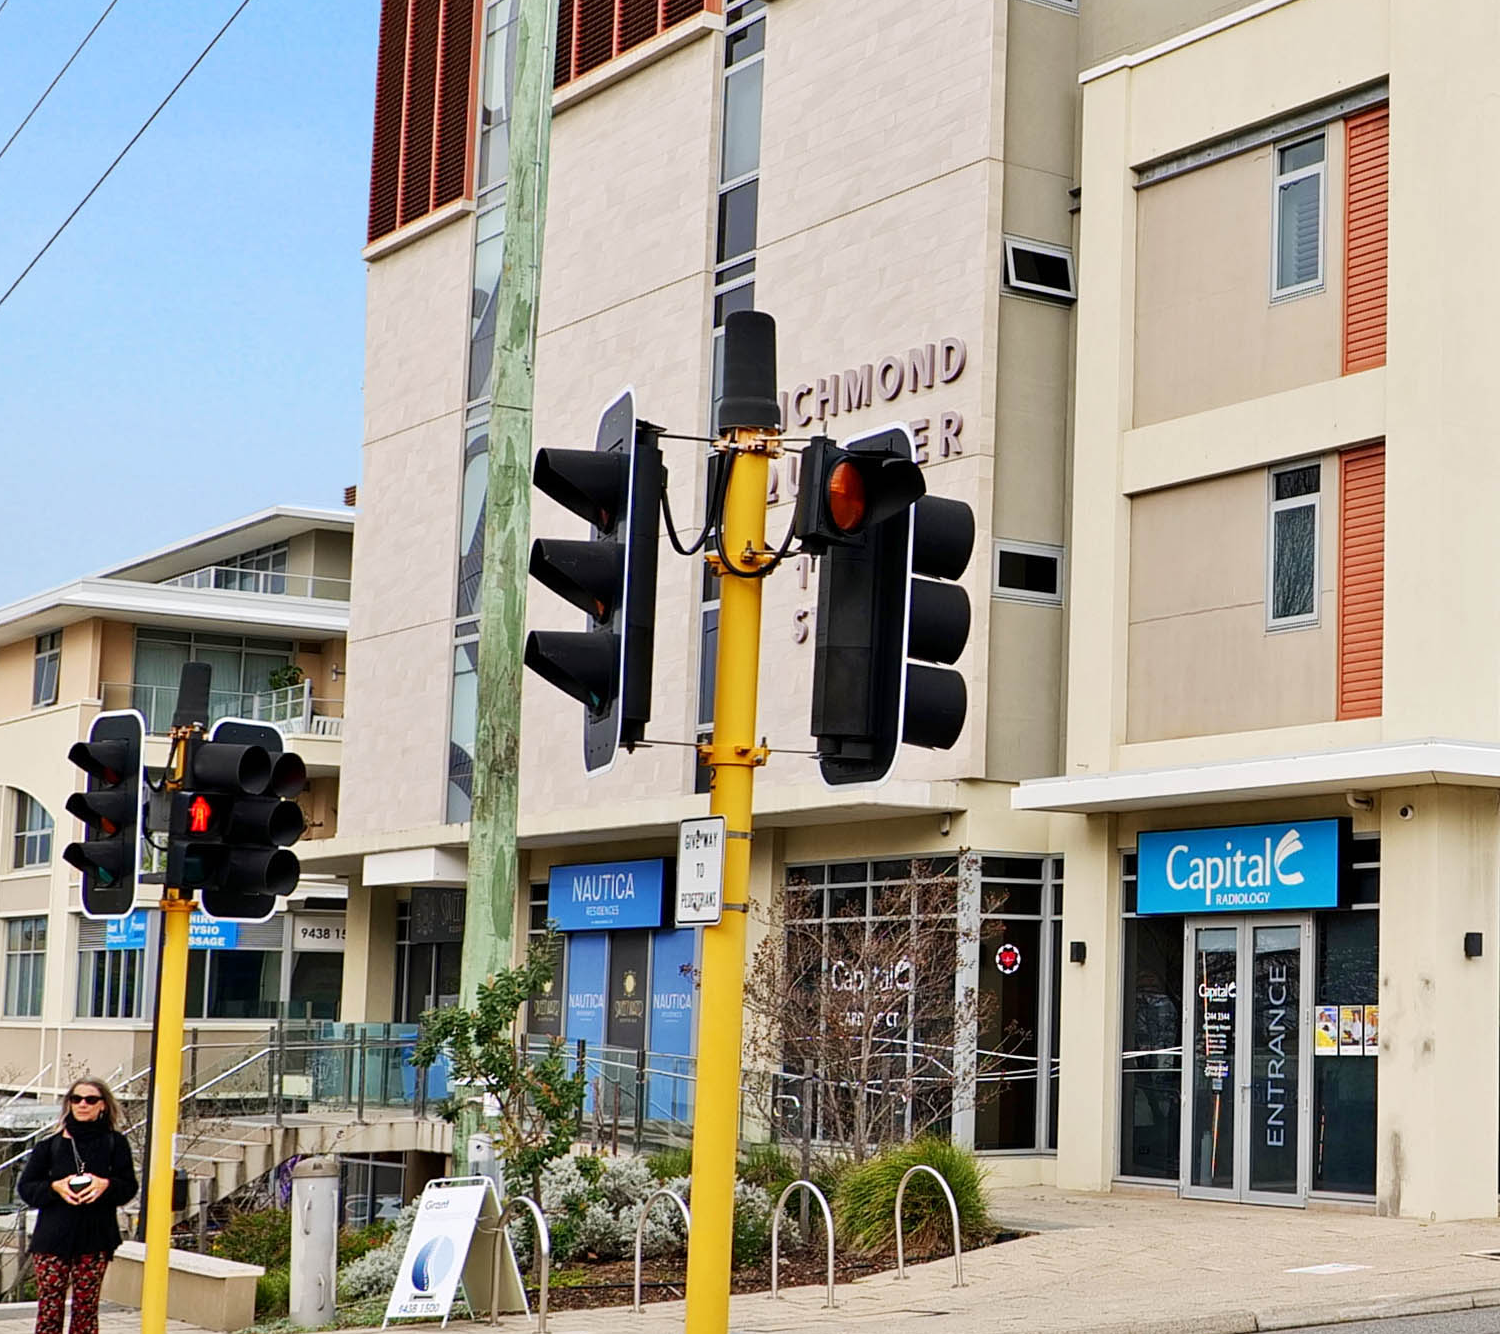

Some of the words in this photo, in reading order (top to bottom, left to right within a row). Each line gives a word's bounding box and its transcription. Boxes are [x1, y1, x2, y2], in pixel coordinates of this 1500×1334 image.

[778, 337, 967, 432] ICHMOND
[696, 862, 705, 878] TO
[1166, 837, 1272, 906] Capital
[572, 873, 635, 902] NAUTICA
[1215, 891, 1271, 905] RADIOLOGY
[301, 928, 330, 939] 9438
[653, 993, 692, 1009] NAUTICA
[1267, 964, 1287, 1147] ENTRANCE
[425, 1199, 450, 1211] Grant
